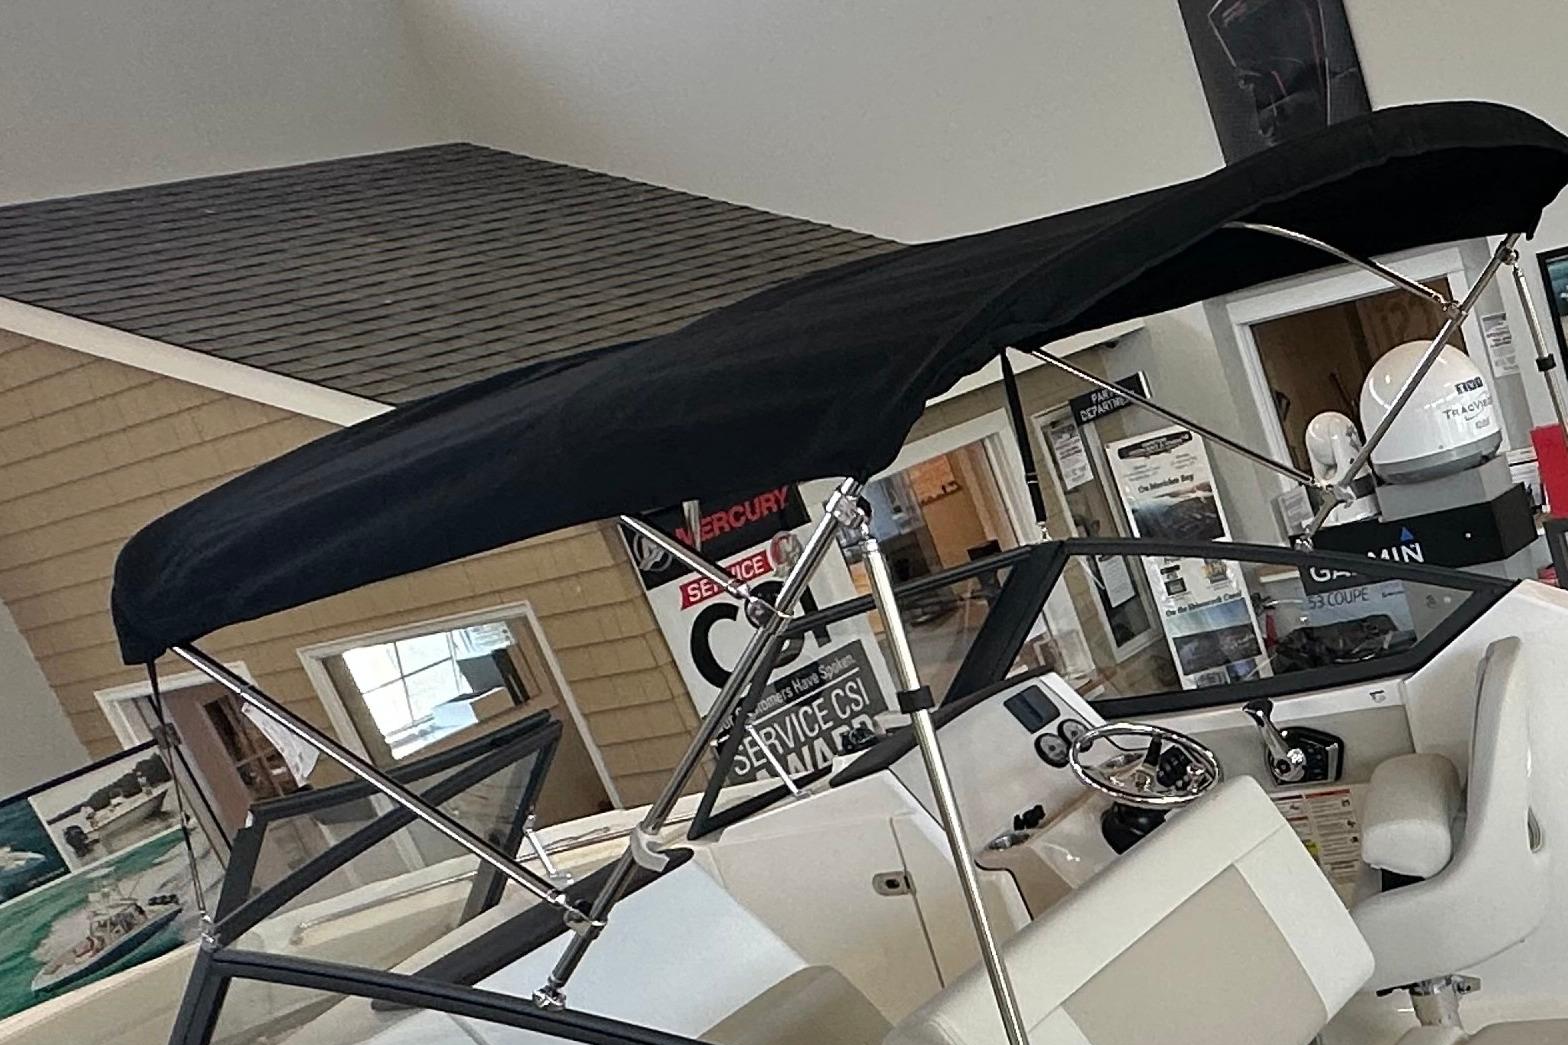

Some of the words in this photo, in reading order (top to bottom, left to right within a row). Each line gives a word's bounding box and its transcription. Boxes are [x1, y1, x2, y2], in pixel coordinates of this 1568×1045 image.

[1327, 587, 1369, 607] COUPE
[791, 672, 820, 694] Have
[733, 697, 834, 776] SERVICE
[831, 677, 870, 720] CSI
